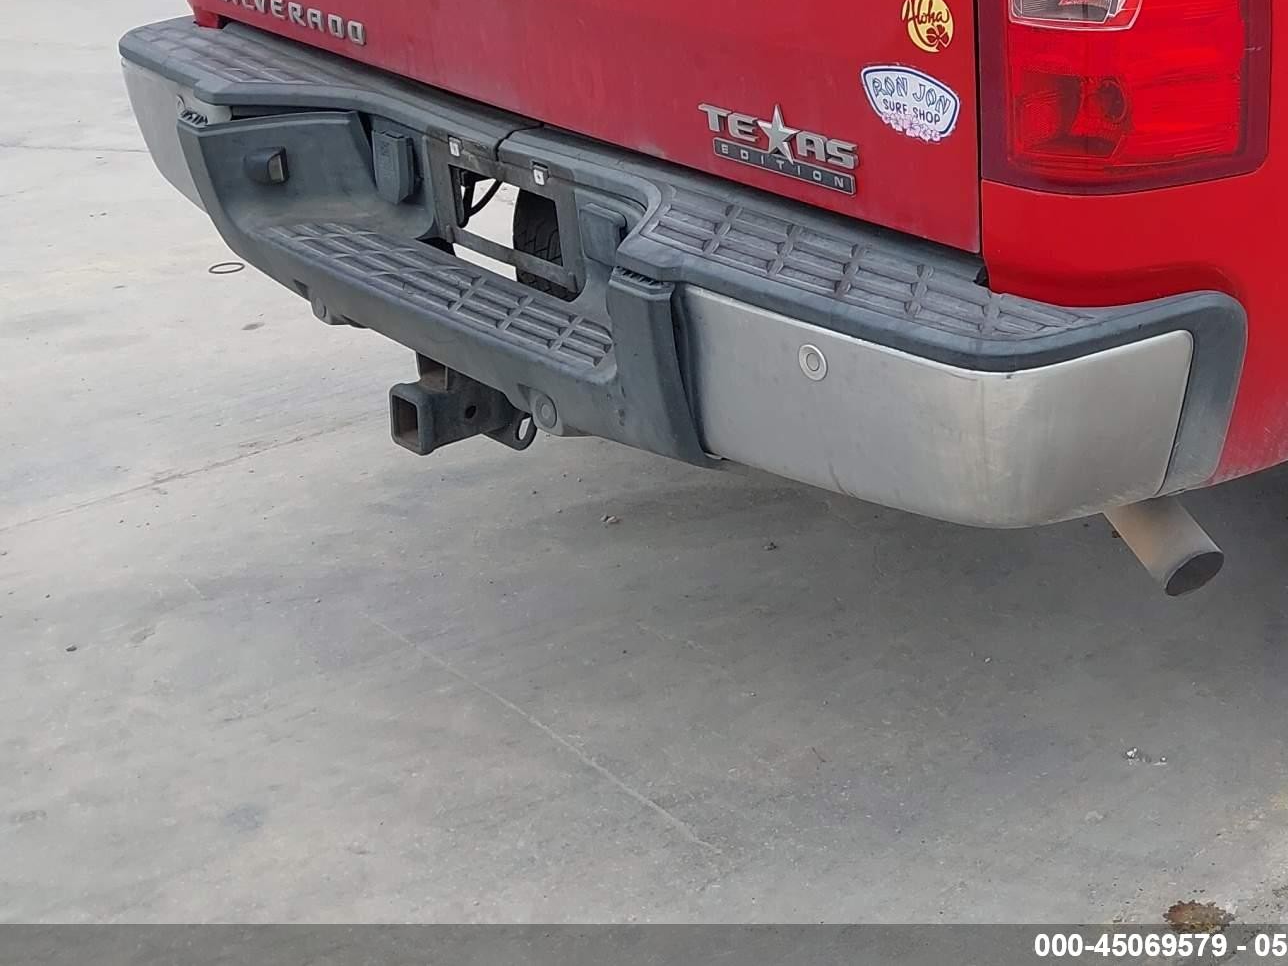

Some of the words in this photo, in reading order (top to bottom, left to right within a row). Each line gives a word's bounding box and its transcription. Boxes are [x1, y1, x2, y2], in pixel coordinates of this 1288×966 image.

[871, 76, 909, 99] RON
[912, 84, 951, 115] JON
[882, 98, 908, 115] SURF
[912, 107, 941, 125] SHOP
[721, 143, 845, 188] EDITION
